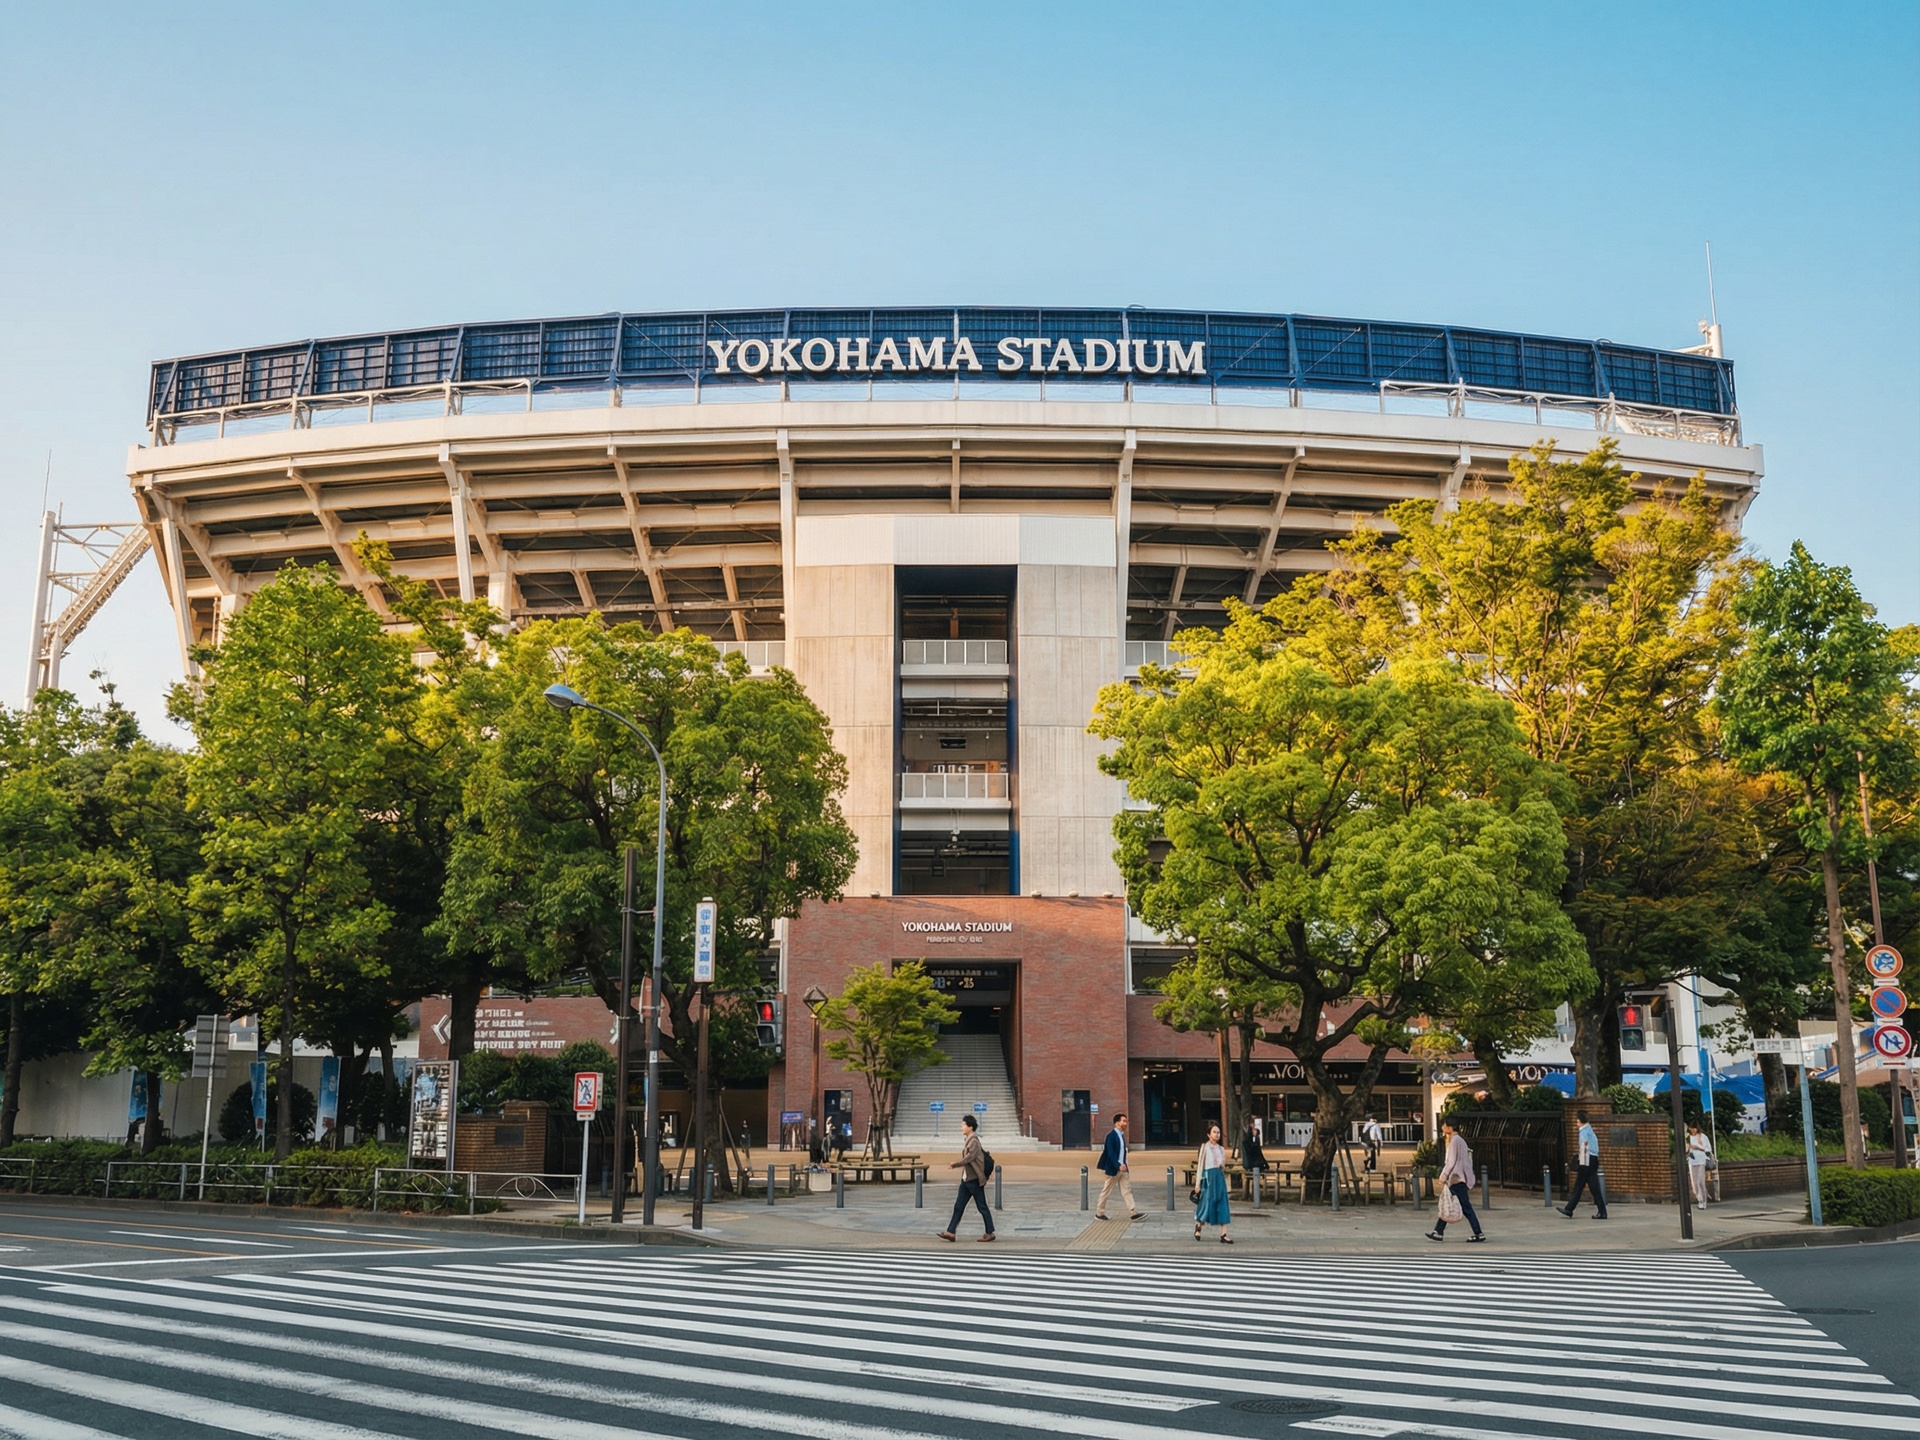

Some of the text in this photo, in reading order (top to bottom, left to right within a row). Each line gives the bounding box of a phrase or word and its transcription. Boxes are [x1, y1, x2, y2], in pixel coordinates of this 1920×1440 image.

[708, 336, 1208, 376] YOKOHAMA STADIUM
[902, 922, 1012, 932] YOKOHAMA STADIUM
